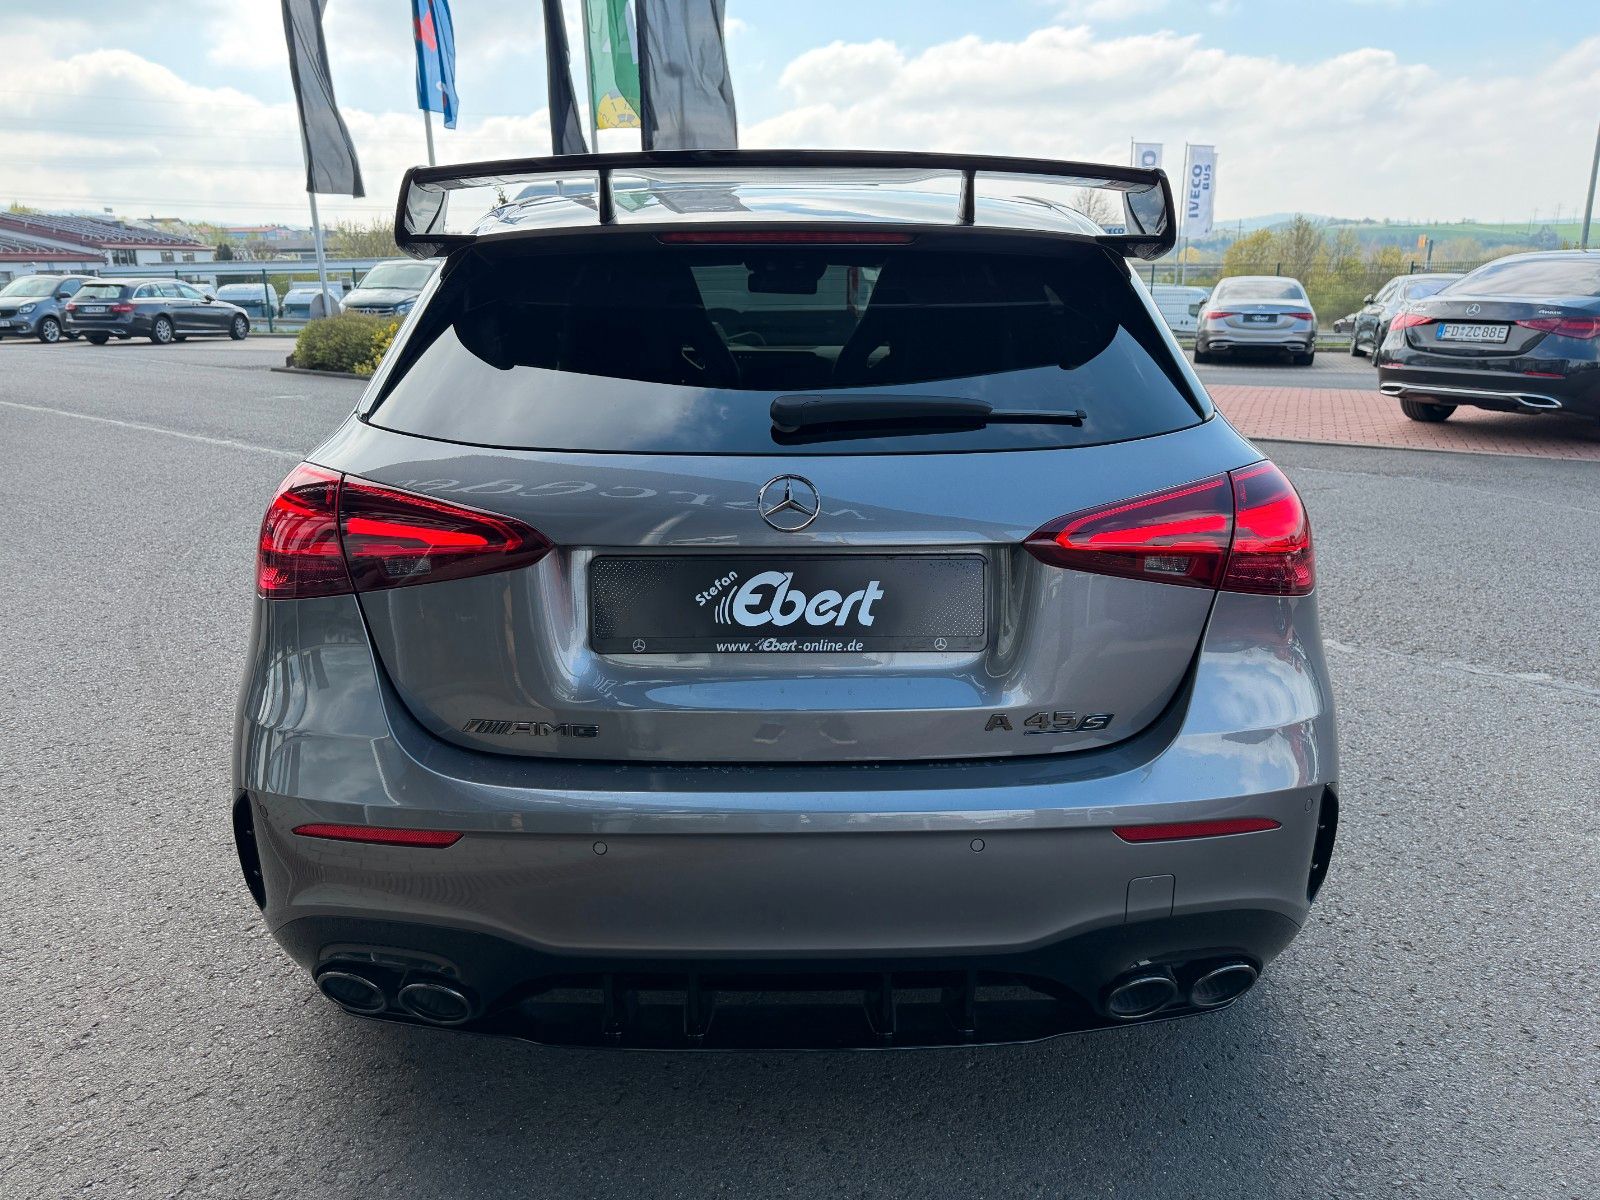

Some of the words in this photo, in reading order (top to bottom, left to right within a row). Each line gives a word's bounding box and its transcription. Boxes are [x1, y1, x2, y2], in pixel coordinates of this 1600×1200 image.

[1202, 163, 1211, 190] BUS
[1188, 164, 1203, 218] IVECO
[1443, 325, 1460, 337] FD
[695, 570, 738, 607] Stefan
[732, 570, 884, 627] Ebert
[506, 720, 600, 738] AMG
[984, 713, 1013, 732] A
